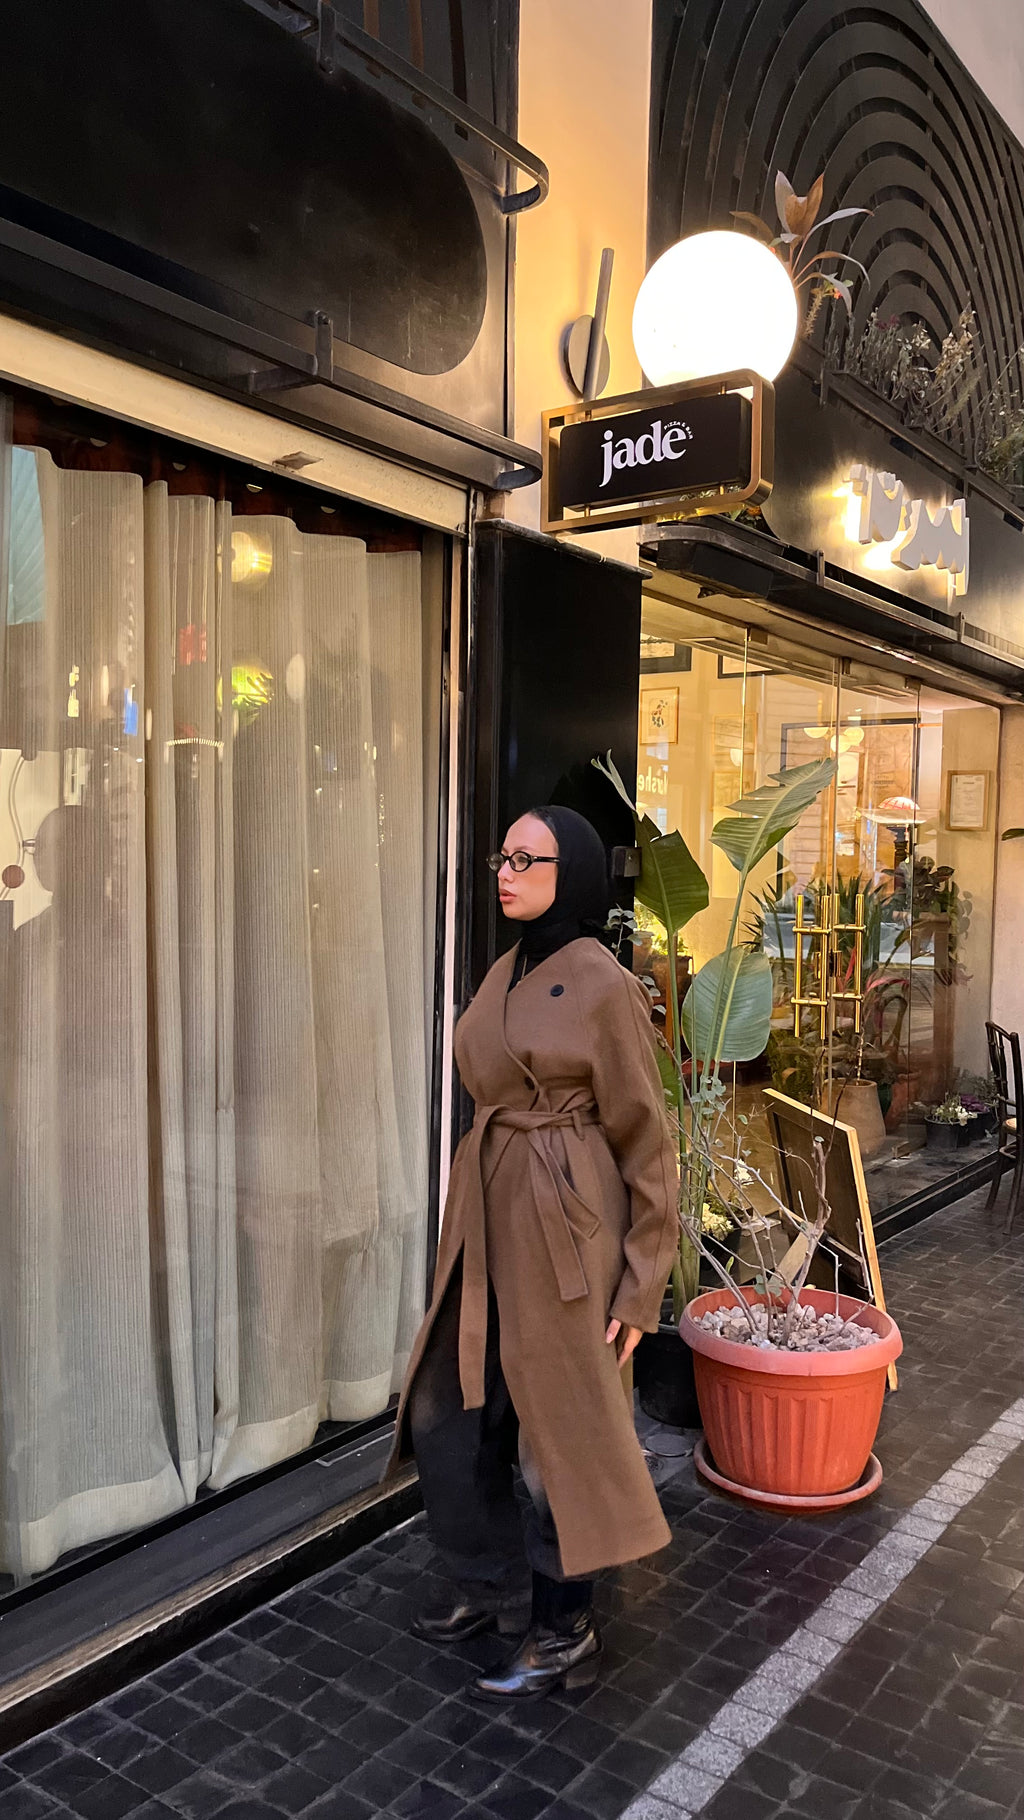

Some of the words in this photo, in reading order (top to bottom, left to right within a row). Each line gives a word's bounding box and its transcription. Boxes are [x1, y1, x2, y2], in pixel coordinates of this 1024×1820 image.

[663, 421, 681, 431] PIZZA
[685, 426, 694, 440] BAR
[598, 419, 687, 488] jade
